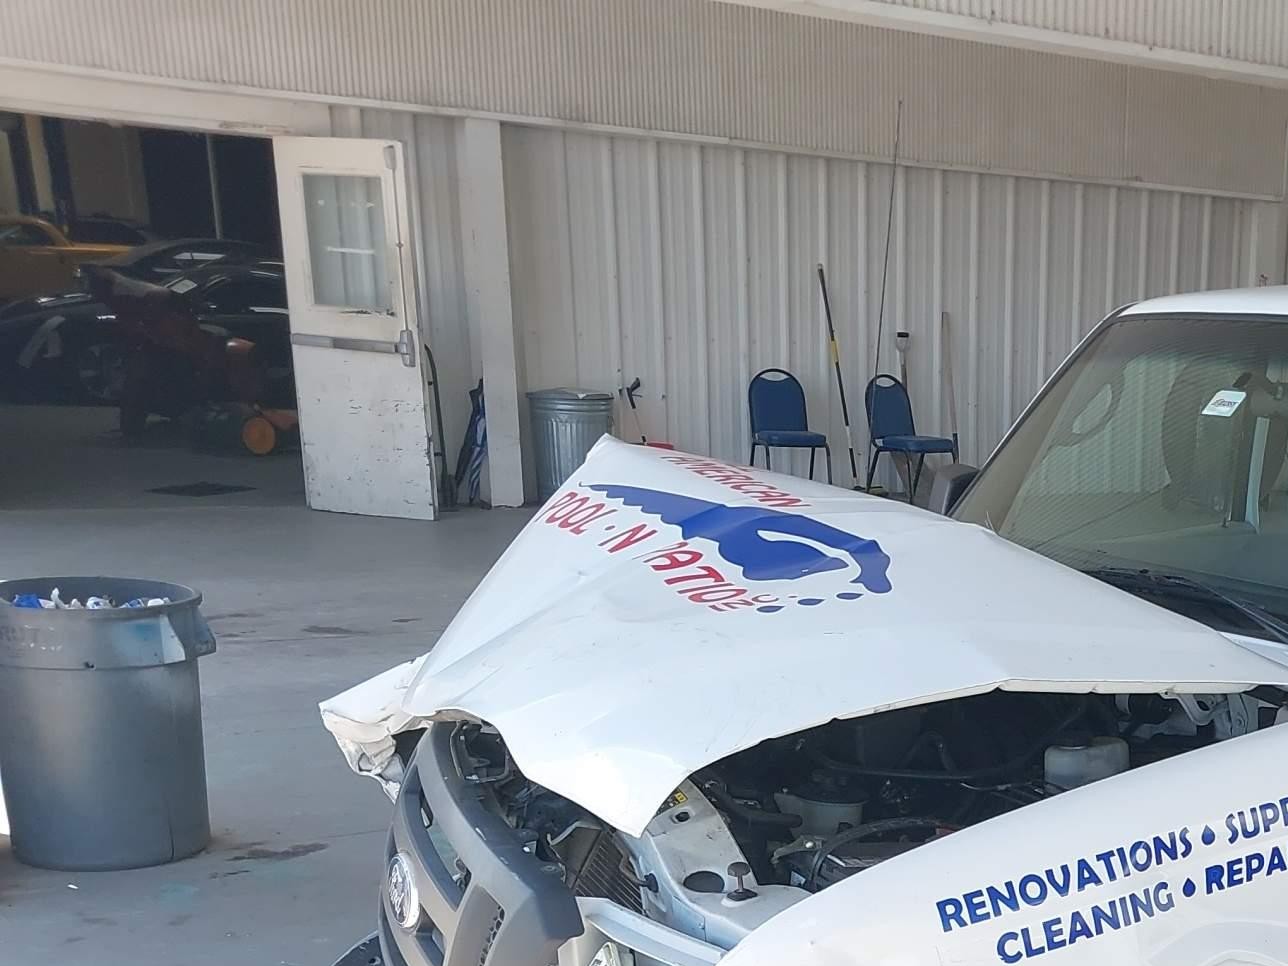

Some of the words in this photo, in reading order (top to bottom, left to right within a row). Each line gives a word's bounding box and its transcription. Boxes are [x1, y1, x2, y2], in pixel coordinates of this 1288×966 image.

[534, 491, 618, 535] POOL
[597, 523, 658, 553] N
[631, 541, 748, 603] PATIO
[936, 825, 1194, 933] RENOVATIONS
[996, 881, 1176, 965] CLEANING
